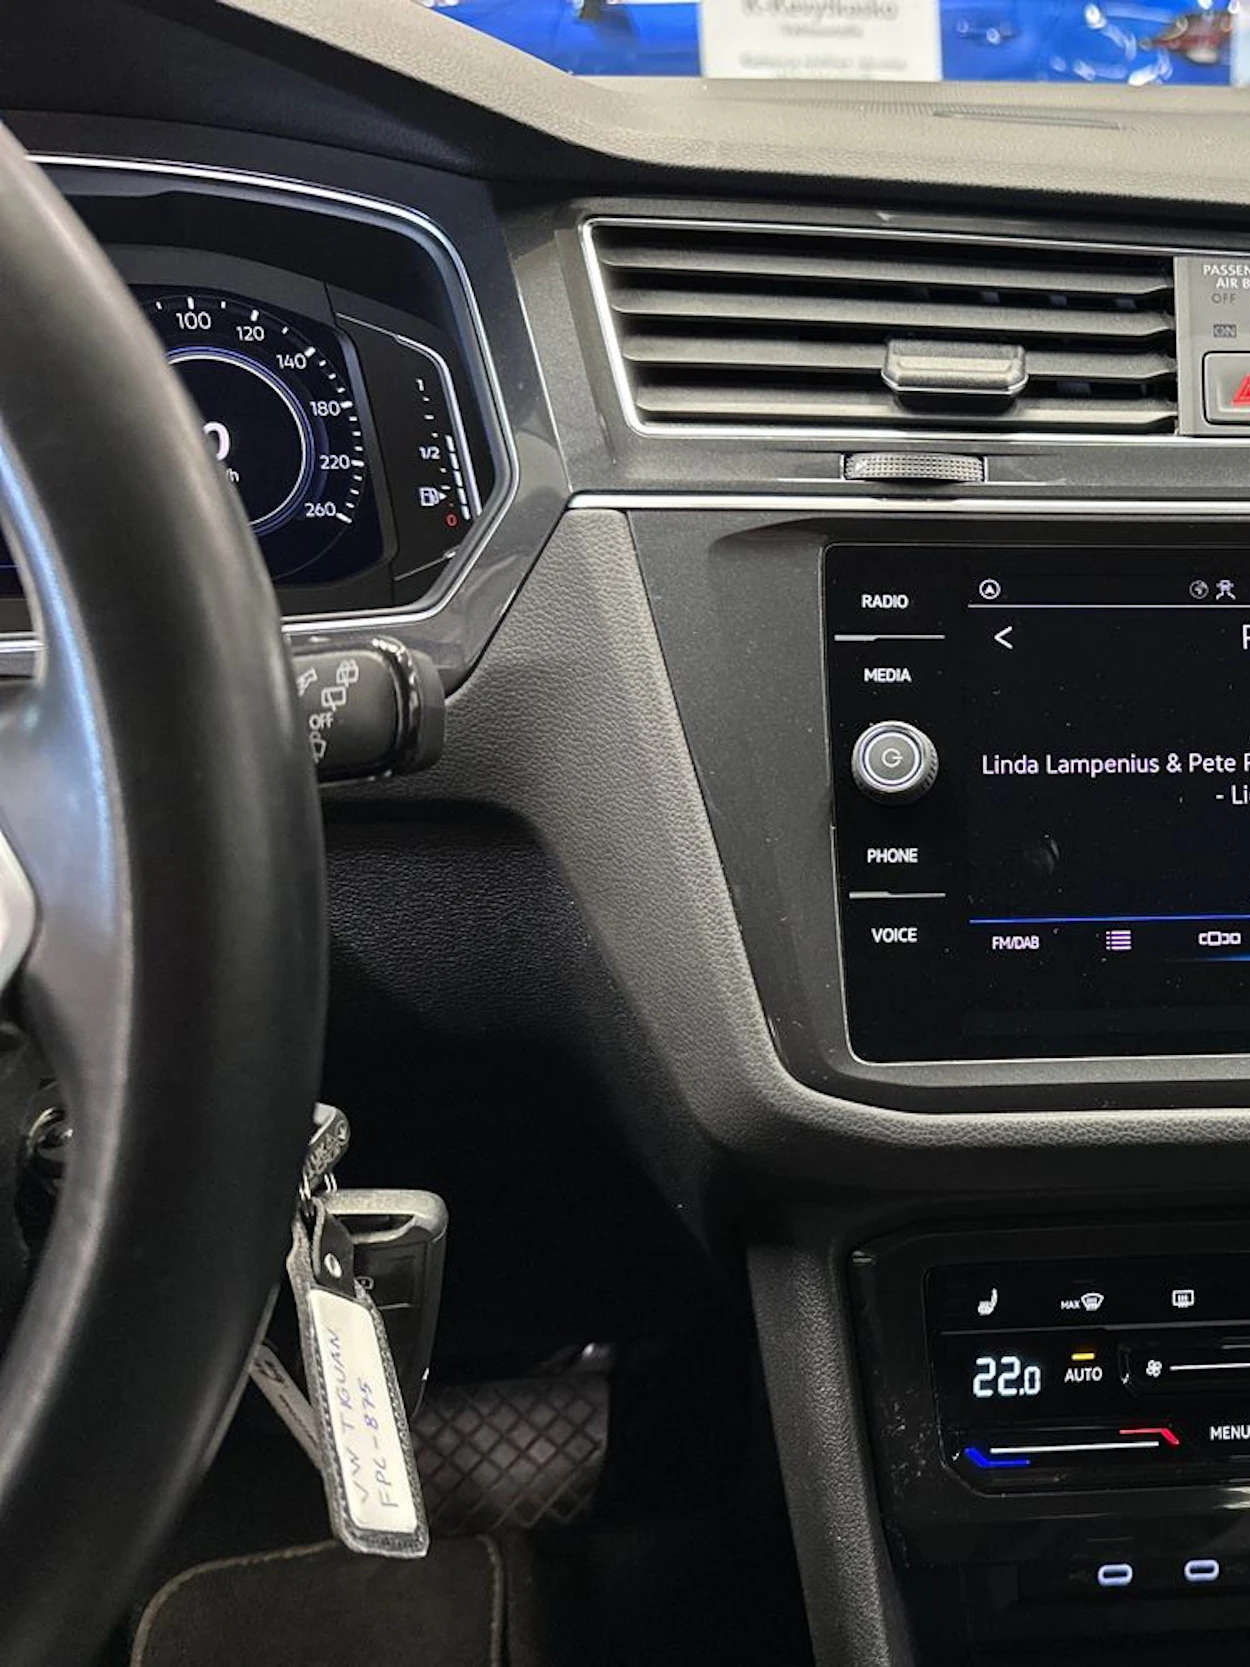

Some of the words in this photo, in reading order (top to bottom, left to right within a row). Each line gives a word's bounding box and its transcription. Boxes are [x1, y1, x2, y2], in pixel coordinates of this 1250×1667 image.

[1216, 278, 1239, 289] AIR
[1211, 294, 1237, 304] OFF
[176, 312, 211, 329] 100
[237, 326, 264, 341] 120
[276, 353, 307, 370] 140
[416, 379, 424, 391] 1
[310, 401, 341, 417] 180
[419, 446, 441, 460] 1/2
[319, 454, 350, 470] 220
[304, 502, 336, 517] 260
[447, 515, 457, 526] 0
[862, 595, 909, 609] RADIO
[864, 668, 911, 682] MEDIA
[983, 755, 1039, 774] Linda
[1047, 754, 1159, 778] Lampenius
[1166, 753, 1182, 773] &
[1189, 753, 1236, 772] Pete
[868, 848, 918, 863] PHONE
[871, 928, 917, 943] VOICE
[993, 936, 1039, 949] FM/DAB
[1060, 1299, 1080, 1310] MAX
[972, 1355, 1042, 1399] 22.0
[1065, 1367, 1102, 1382] AUTO
[1211, 1425, 1250, 1440] MENU
[349, 1447, 368, 1503] VW
